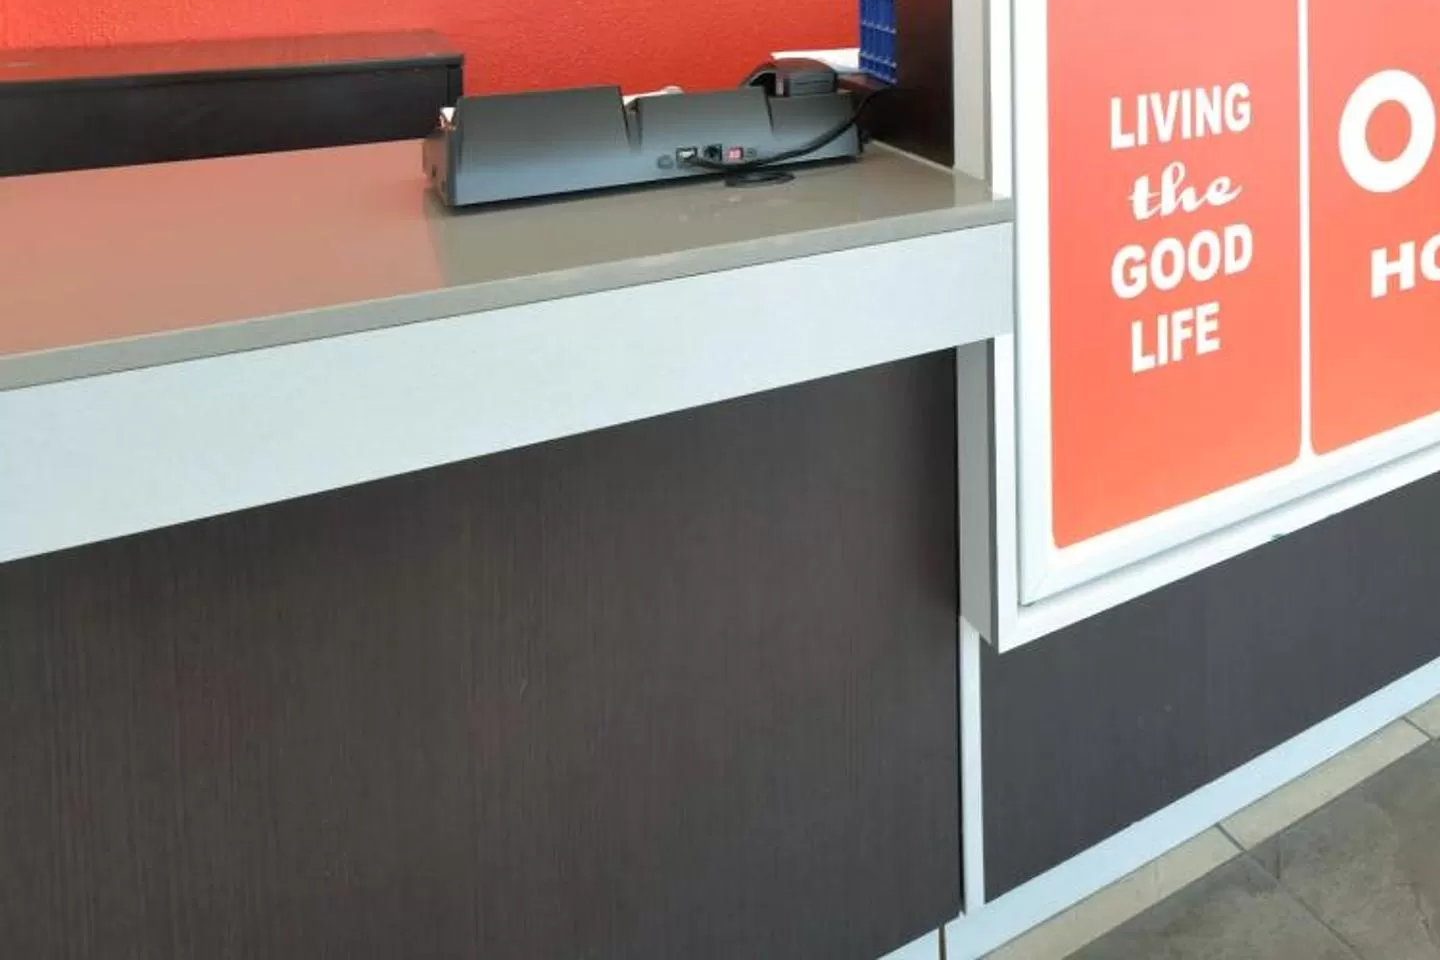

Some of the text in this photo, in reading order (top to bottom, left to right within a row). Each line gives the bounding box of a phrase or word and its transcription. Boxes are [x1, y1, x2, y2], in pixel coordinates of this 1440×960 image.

[1110, 82, 1252, 150] LIVING
[1128, 161, 1241, 221] the
[1111, 223, 1254, 300] GOOD
[1130, 301, 1221, 374] LIFE
